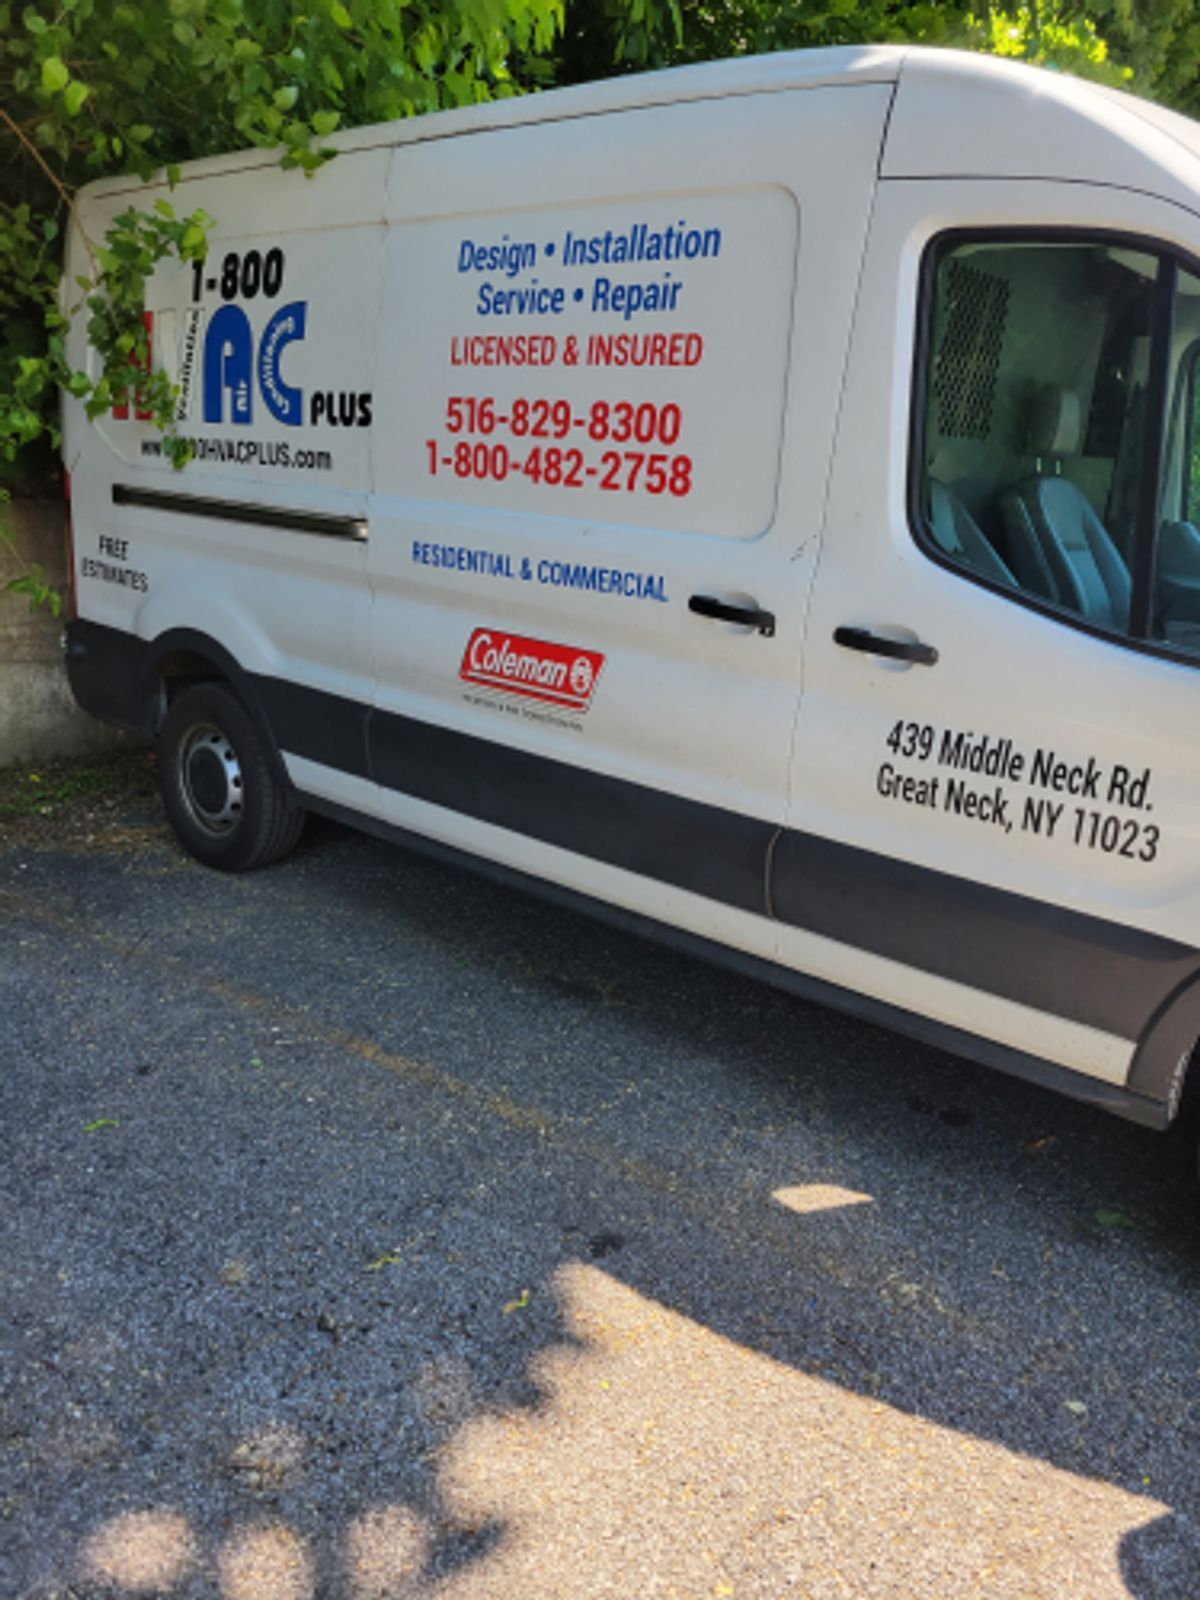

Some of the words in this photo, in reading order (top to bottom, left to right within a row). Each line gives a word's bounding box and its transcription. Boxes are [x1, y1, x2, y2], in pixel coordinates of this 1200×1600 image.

[192, 247, 284, 302] 1-800
[458, 235, 536, 278] Design
[563, 220, 721, 266] Installation
[476, 278, 565, 315] Service
[592, 272, 682, 320] Repair
[451, 336, 556, 366] LICENSED
[563, 335, 579, 366] &
[586, 333, 703, 366] INSURED
[310, 391, 373, 427] PLUS
[446, 397, 682, 446] 516-829-8300
[426, 439, 692, 497] 1-800-482-2758
[99, 534, 129, 561] FREE
[412, 541, 514, 578] RESIDENTIAL
[519, 557, 532, 581] &
[537, 560, 668, 602] COMMERCIAL
[469, 634, 567, 689] Coleman
[886, 720, 935, 760] 439
[937, 730, 1025, 782] Middle
[1030, 749, 1102, 799] Neck
[1107, 765, 1153, 811] Rd.
[877, 763, 938, 808] Great
[944, 778, 1012, 834] Neck,
[1021, 797, 1064, 837] NY
[1074, 808, 1160, 862] 11023
